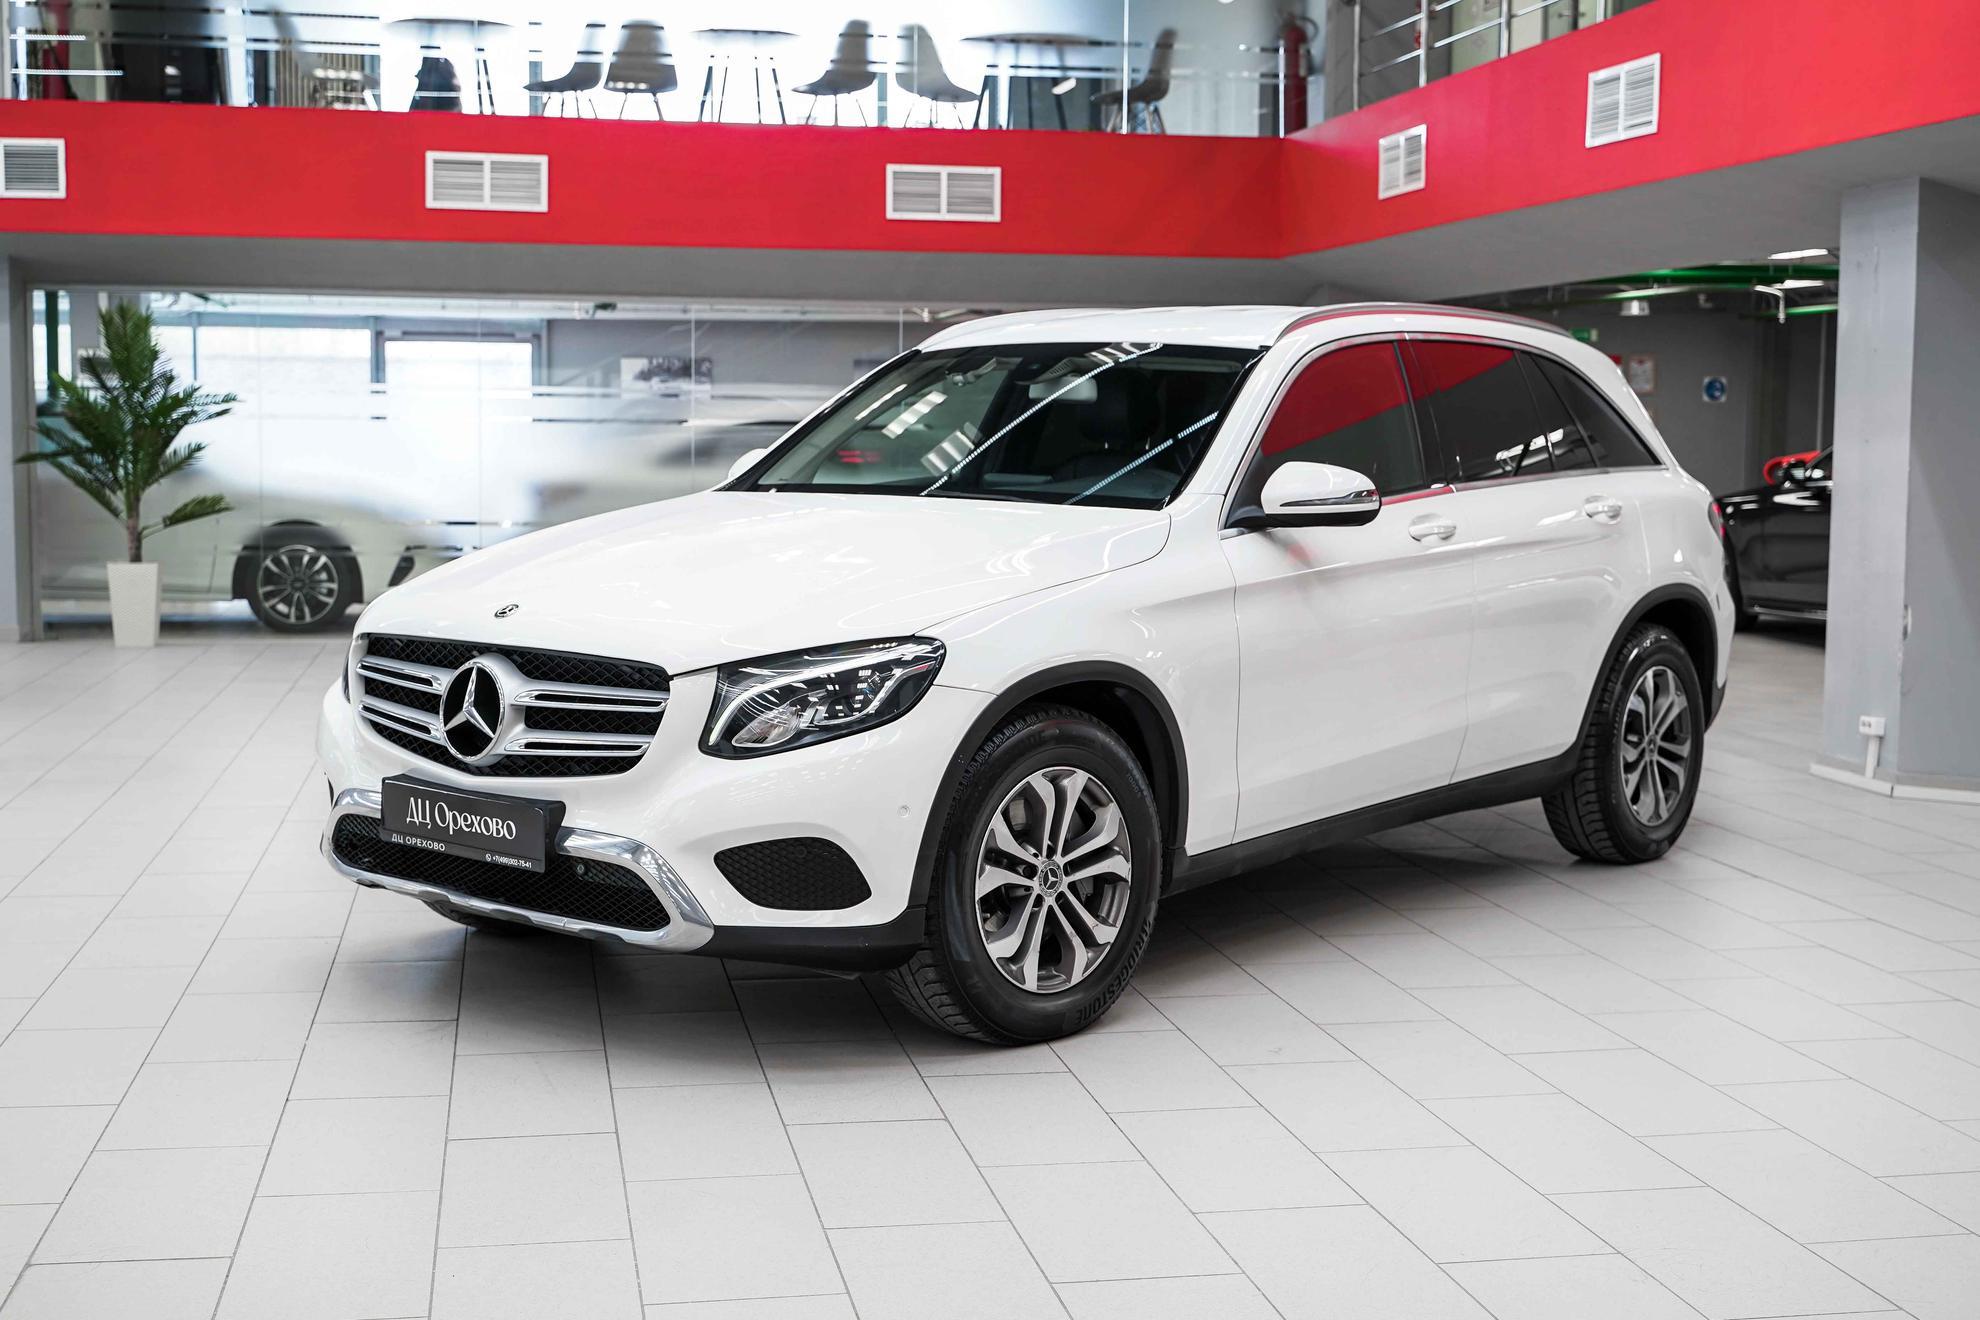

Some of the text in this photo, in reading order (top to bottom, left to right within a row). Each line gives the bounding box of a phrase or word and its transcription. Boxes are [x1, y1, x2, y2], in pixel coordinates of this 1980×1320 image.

[406, 796, 516, 840] ДЦ Орехово
[391, 833, 446, 852] ДЦ ОРЕХОВО
